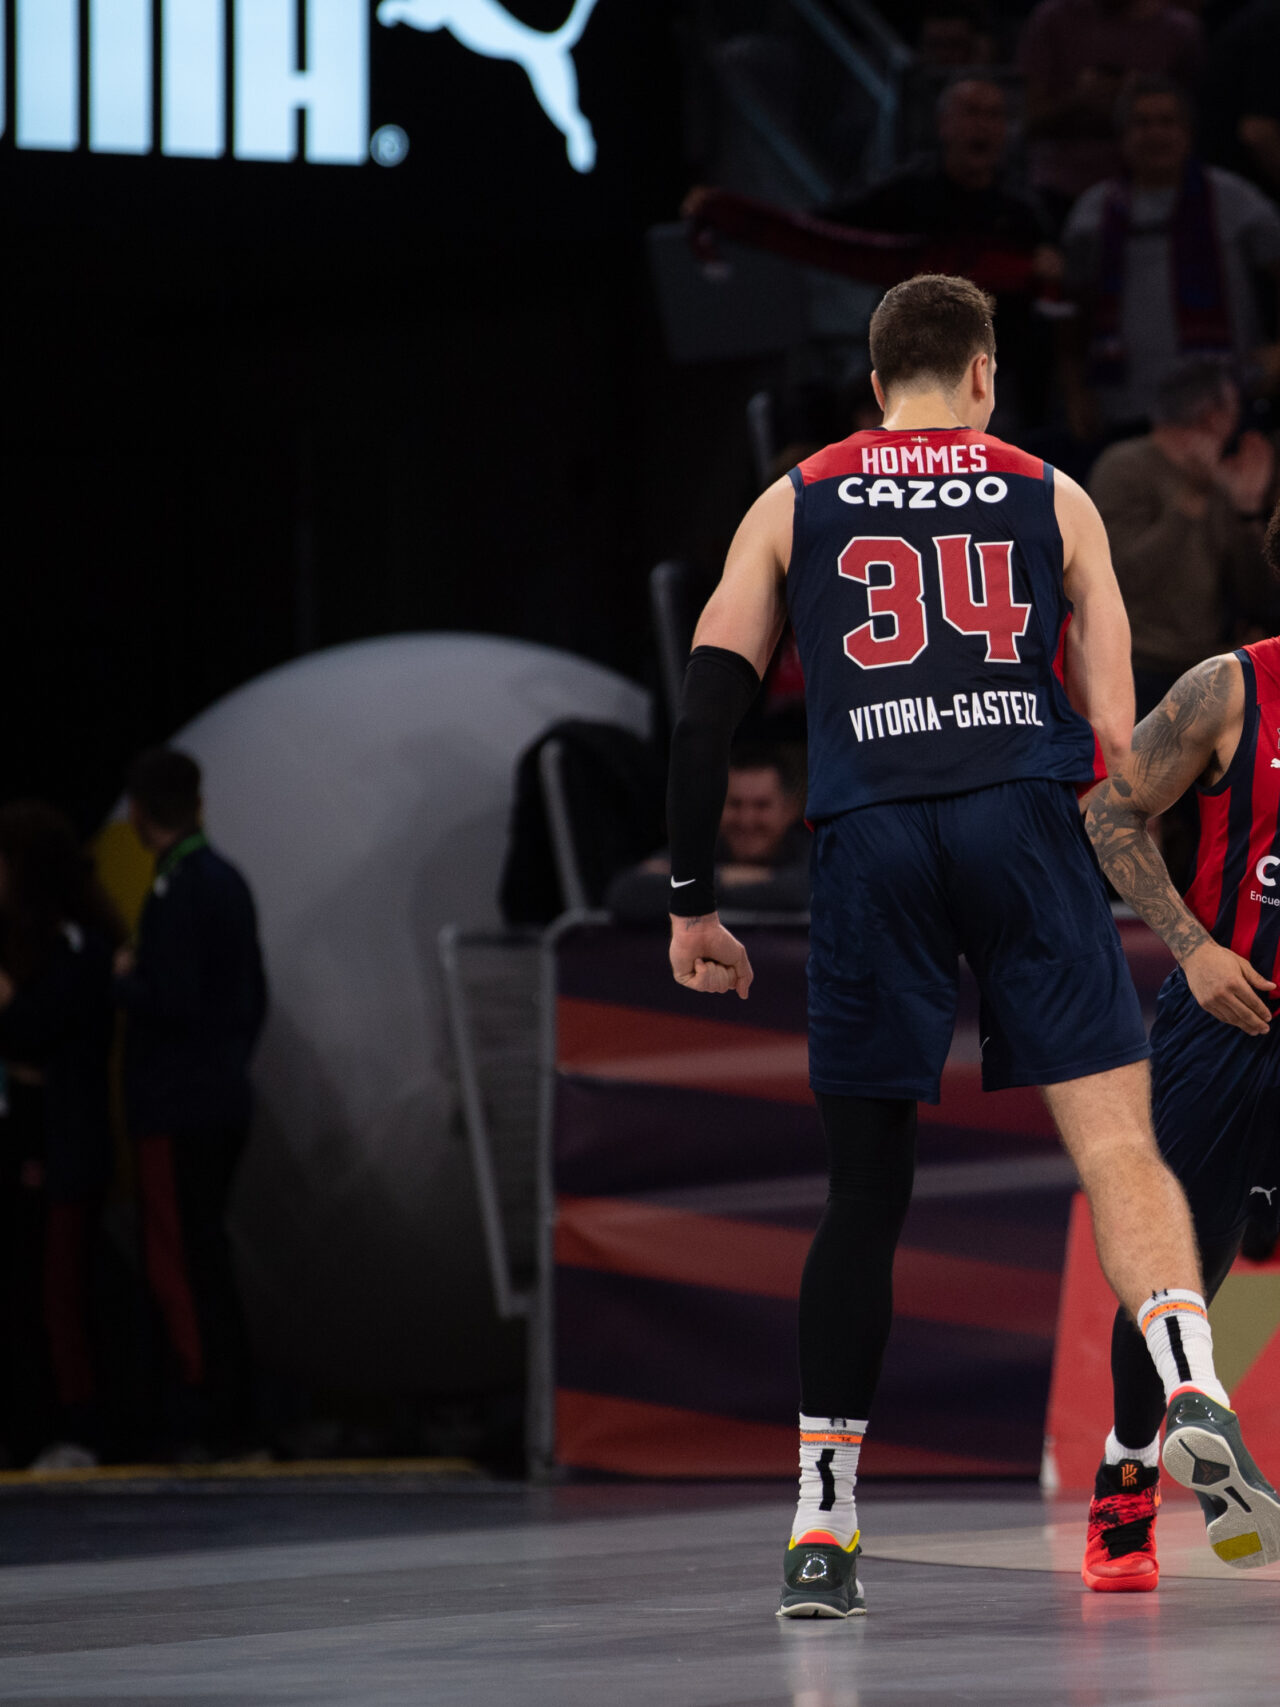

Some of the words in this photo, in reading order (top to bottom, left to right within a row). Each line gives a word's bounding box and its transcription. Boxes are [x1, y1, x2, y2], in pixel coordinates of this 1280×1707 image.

[861, 444, 987, 475] HOMMES
[838, 476, 1008, 509] CAZOO
[837, 534, 1032, 670] 34
